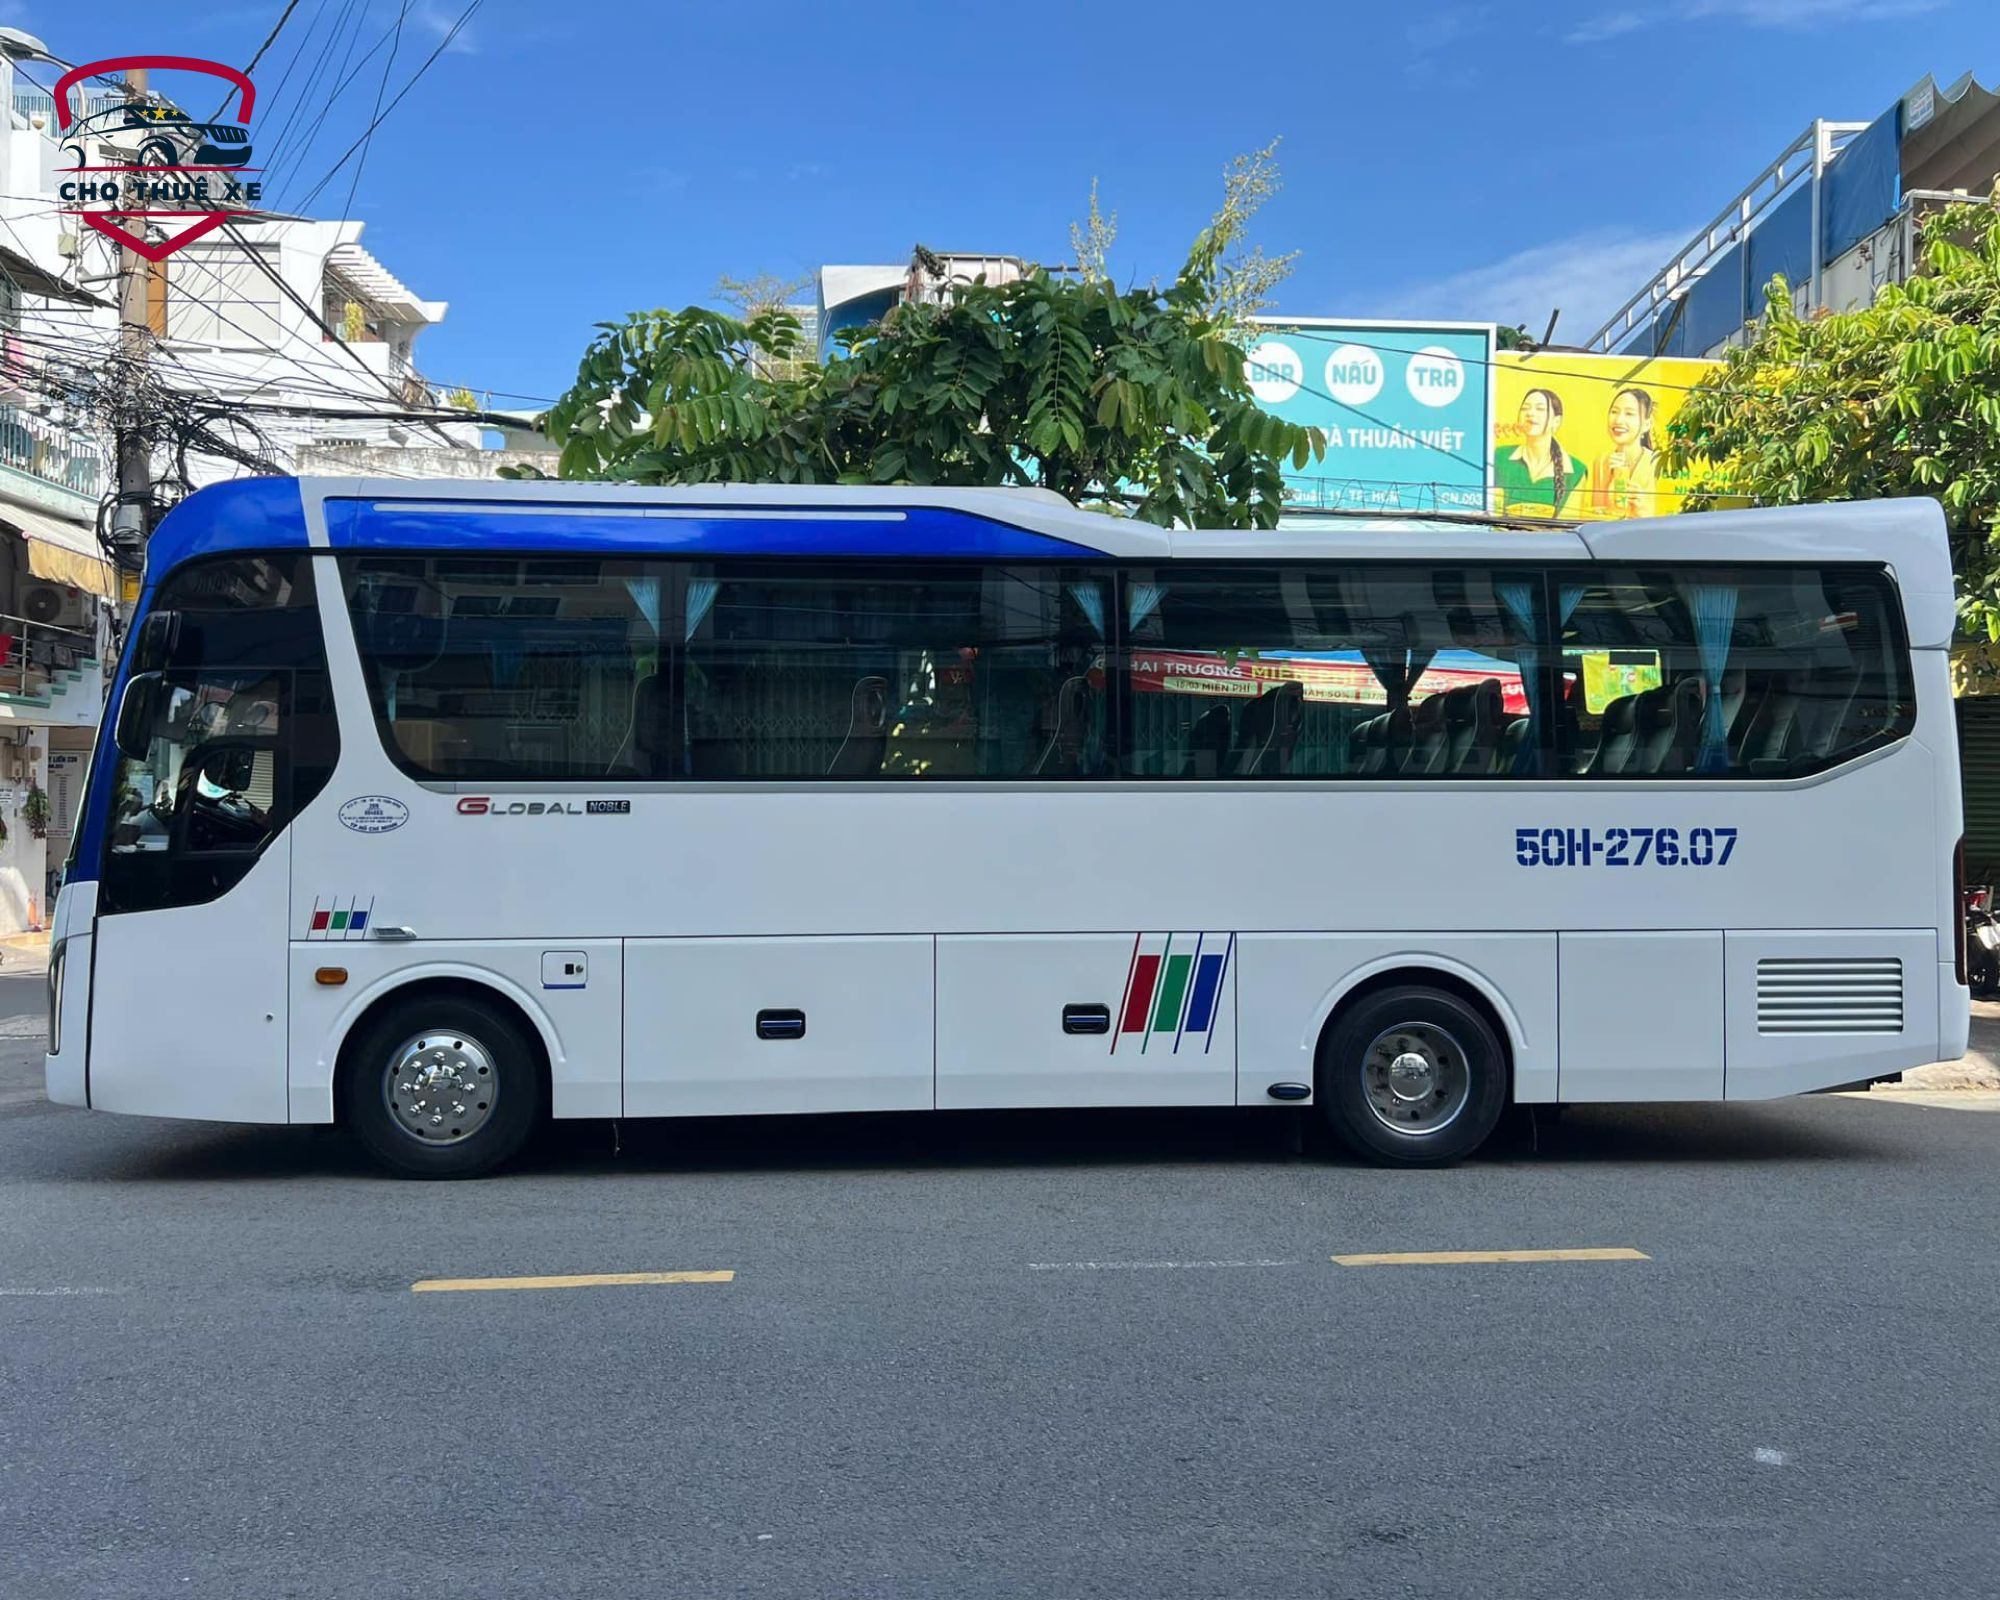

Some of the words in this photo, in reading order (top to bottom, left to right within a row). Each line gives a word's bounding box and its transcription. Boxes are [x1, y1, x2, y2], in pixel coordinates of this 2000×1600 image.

[1332, 358, 1377, 386] NẤU
[1413, 359, 1458, 388] TRÀ
[1420, 425, 1465, 452] VIỆT
[1130, 660, 1159, 673] HAI
[456, 797, 583, 815] GLOBAL
[588, 800, 629, 813] NOBLE
[1515, 828, 1738, 866] 50H-276.07
